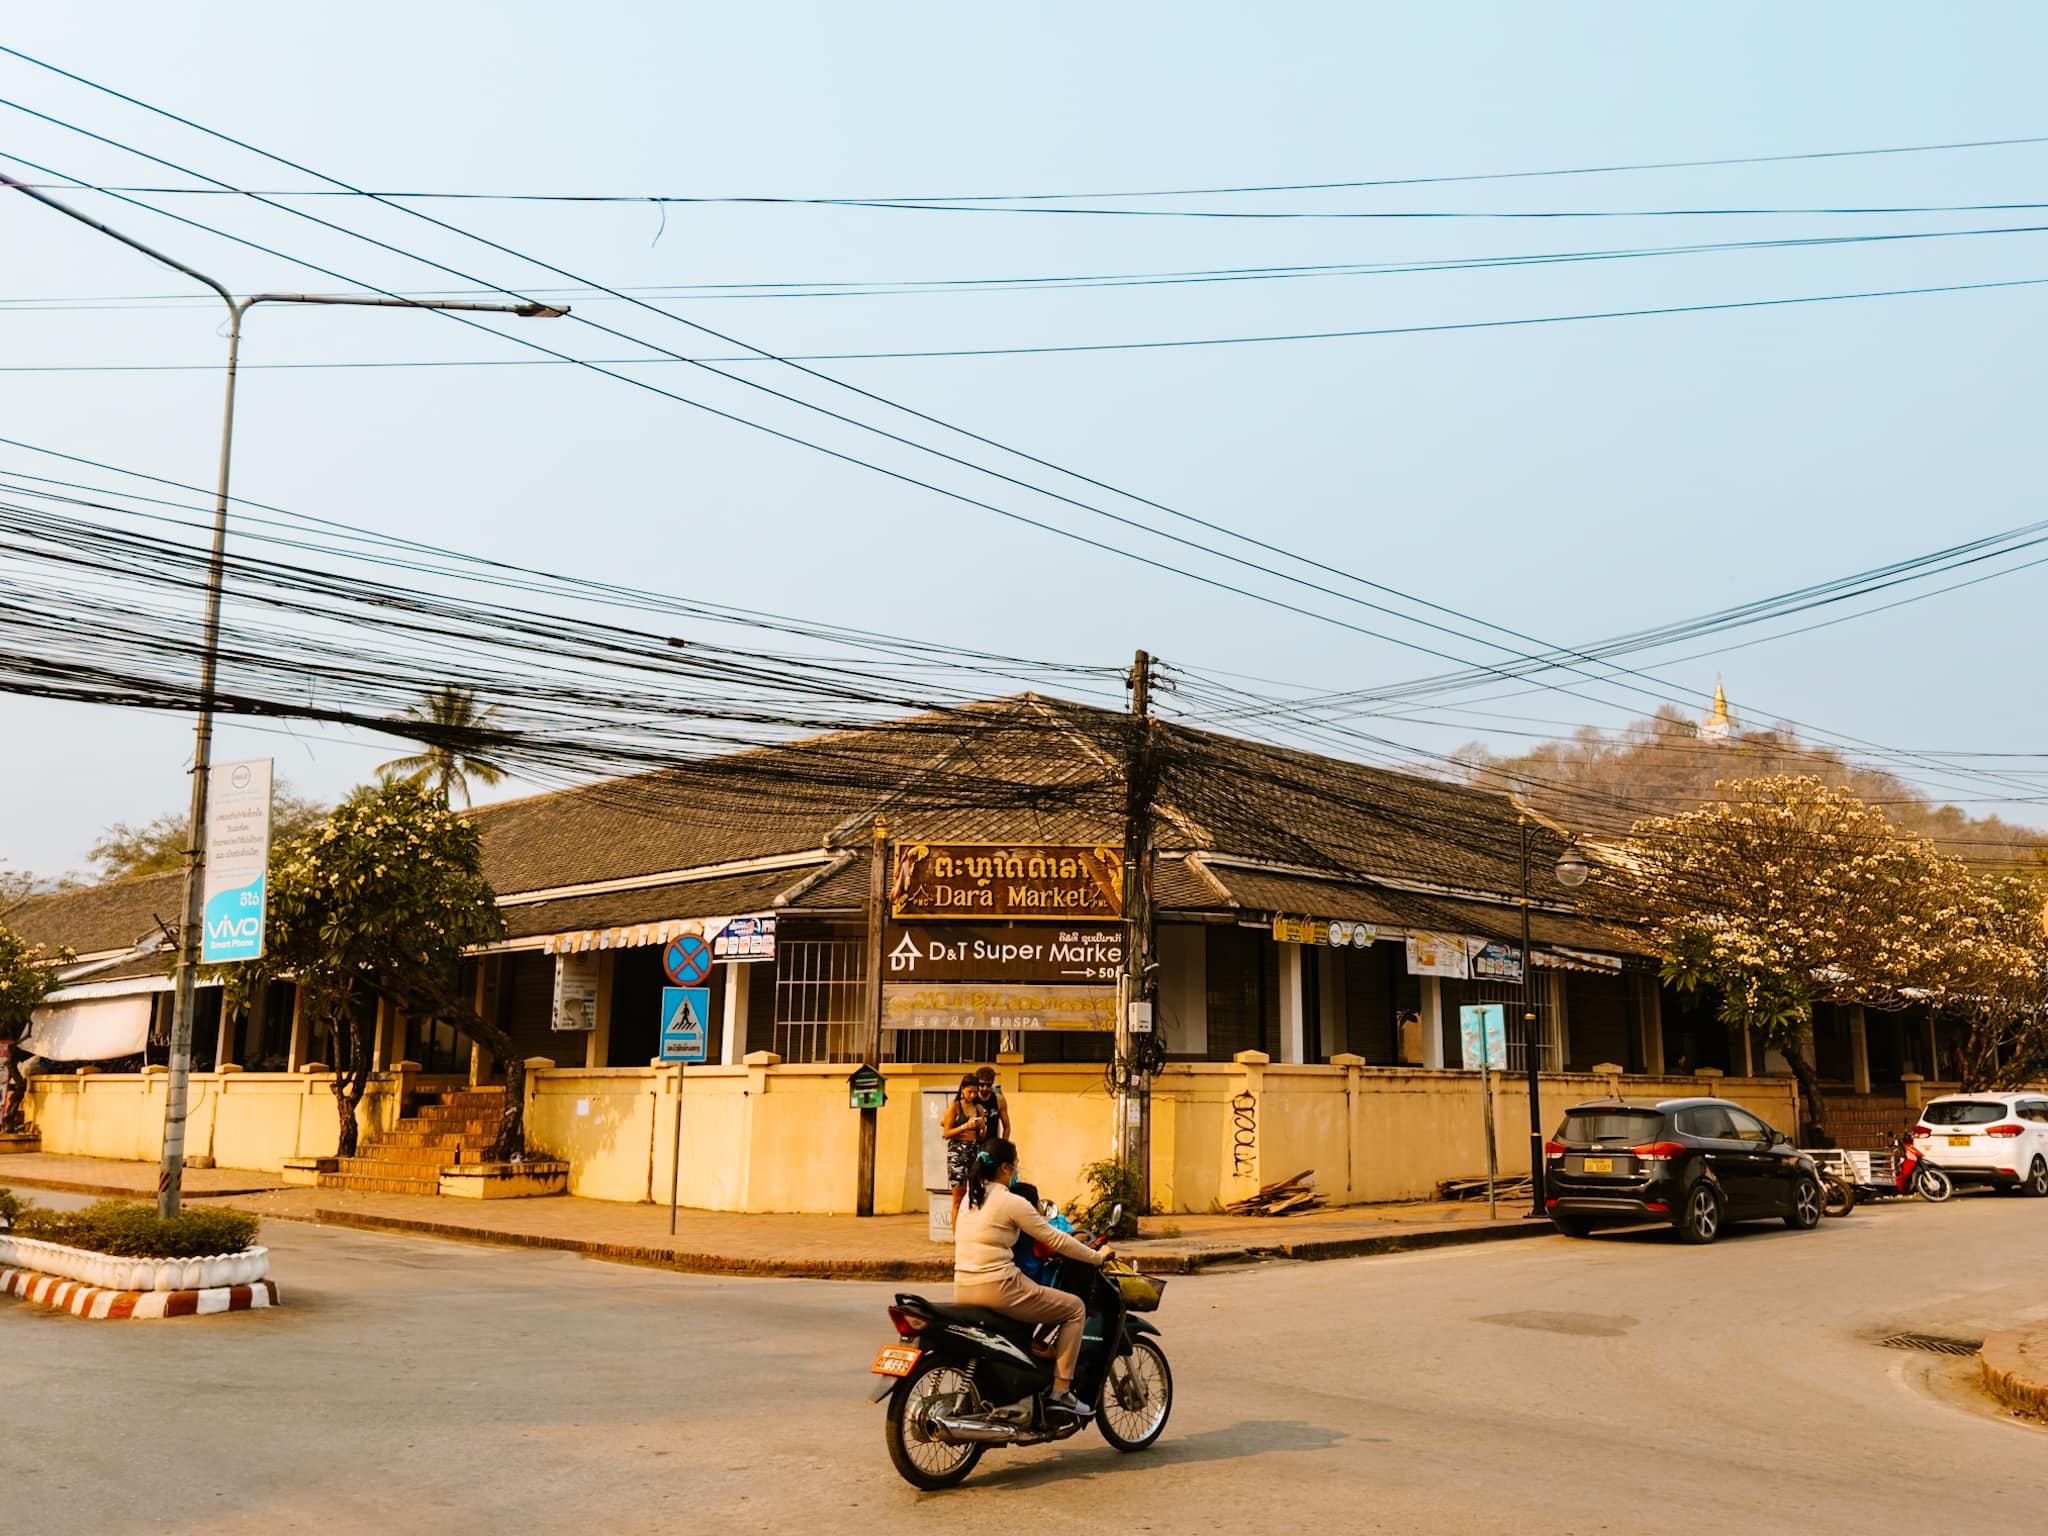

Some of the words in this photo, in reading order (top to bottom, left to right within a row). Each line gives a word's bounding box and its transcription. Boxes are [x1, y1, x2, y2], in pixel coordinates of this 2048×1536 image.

[935, 885, 993, 907] Dara
[1007, 885, 1091, 907] Market
[891, 954, 915, 971] DT
[929, 941, 968, 961] D&T
[973, 940, 1042, 963] Super
[1048, 943, 1121, 963] Marke
